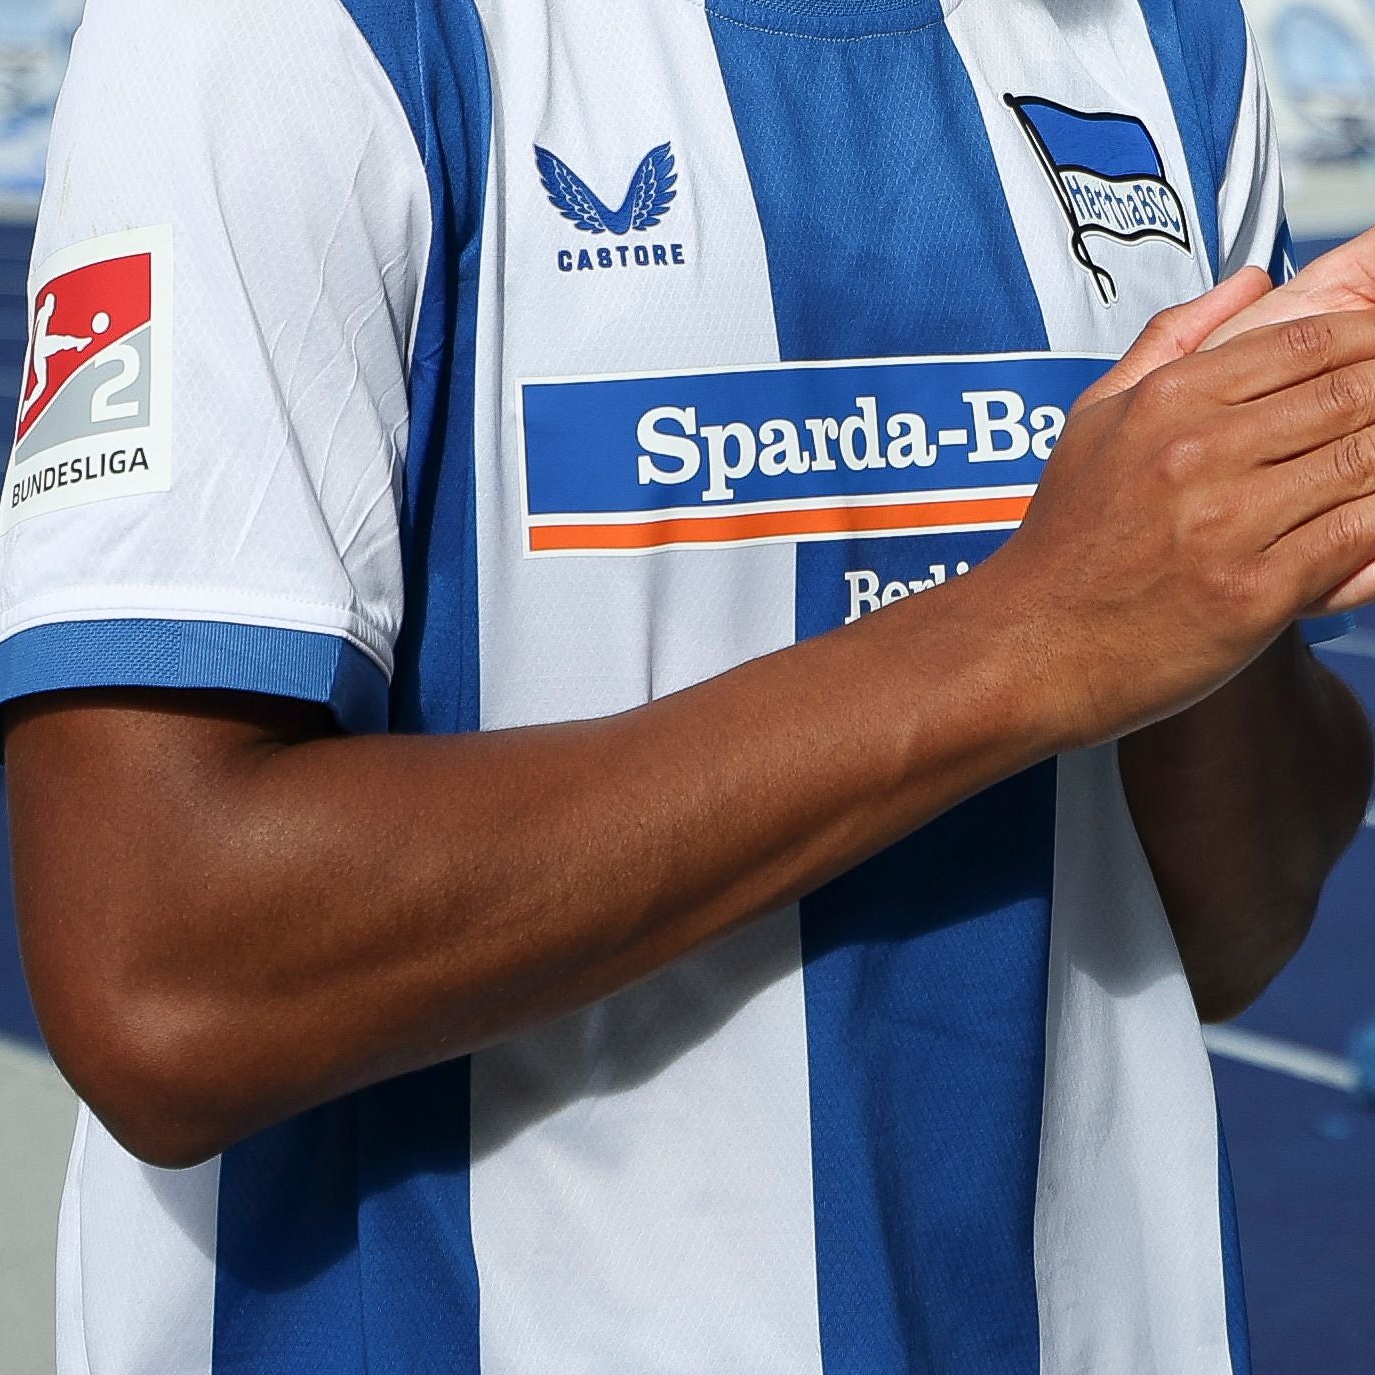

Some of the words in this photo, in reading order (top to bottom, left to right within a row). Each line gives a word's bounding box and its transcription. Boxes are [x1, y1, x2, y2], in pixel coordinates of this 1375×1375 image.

[557, 243, 686, 273] CASTORE
[90, 343, 141, 424] 2
[11, 446, 150, 509] BUNDESLIGA
[635, 389, 1067, 502] Sparda-Ba
